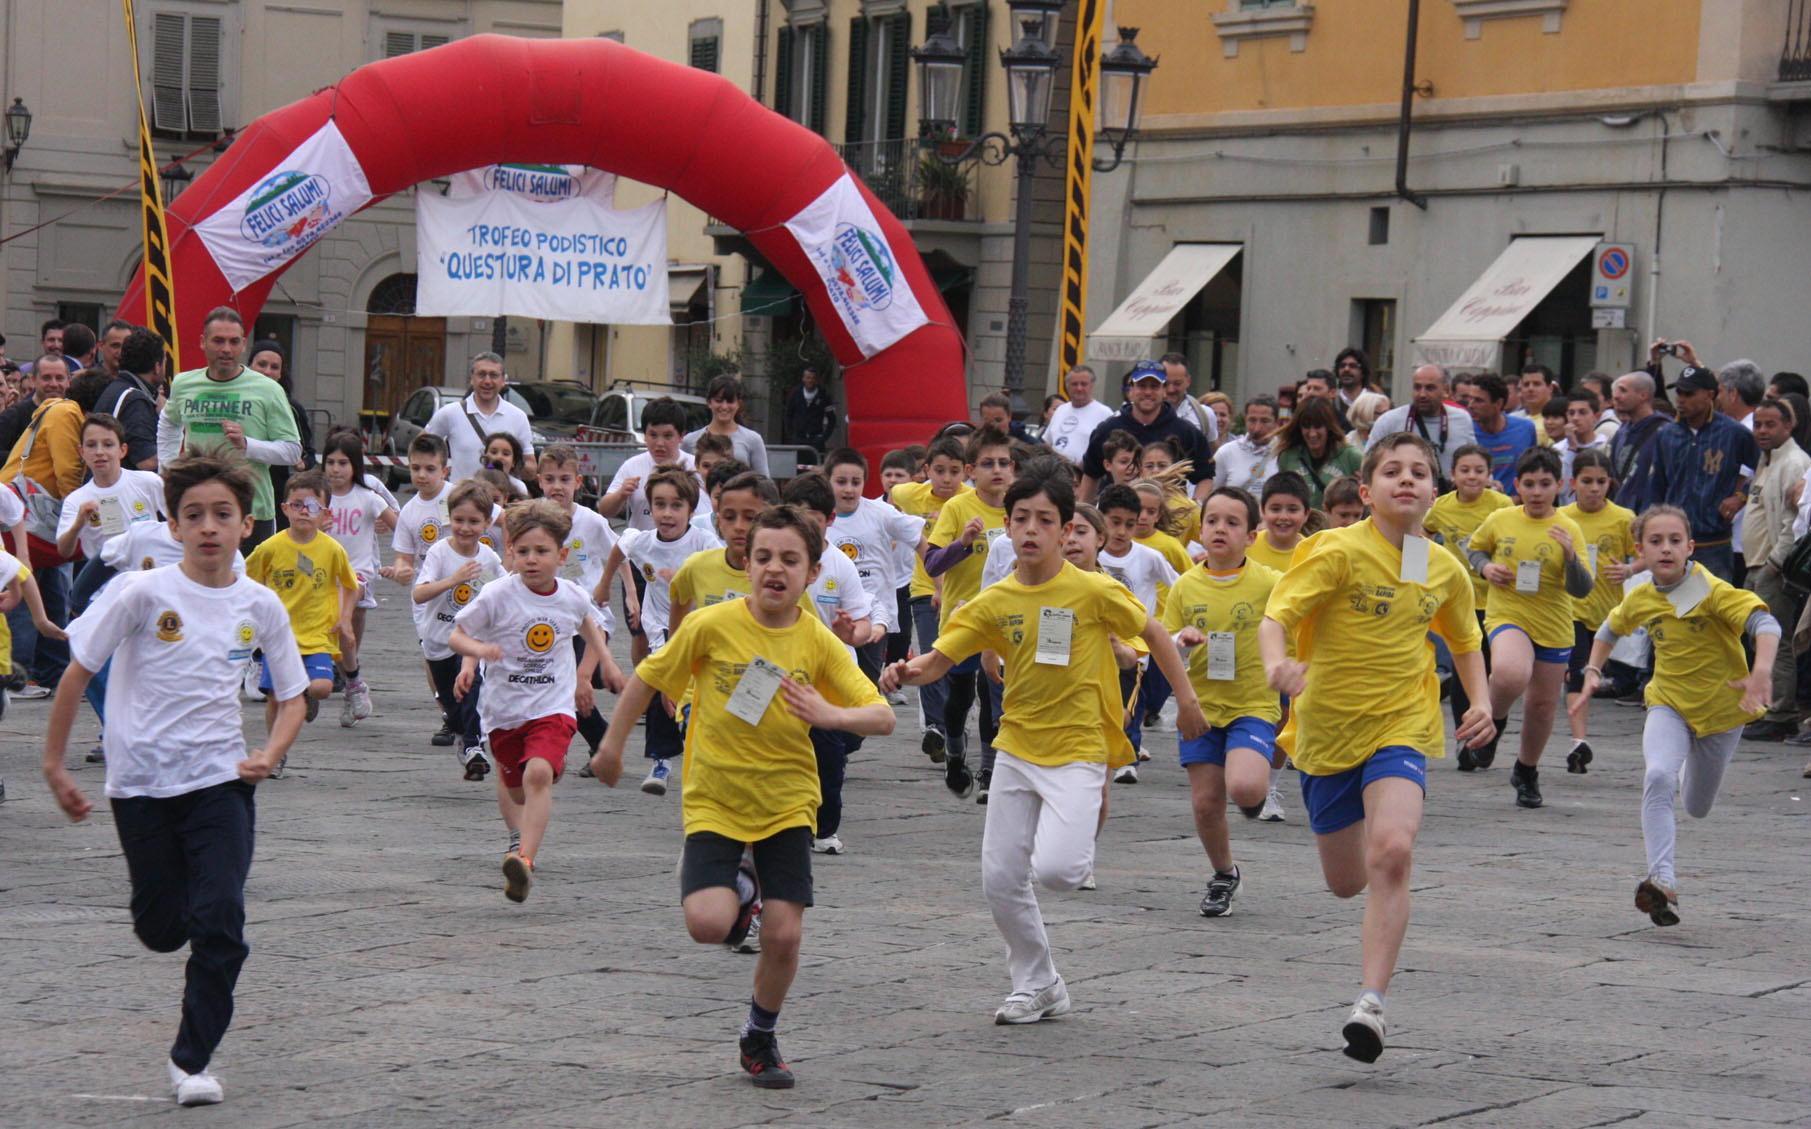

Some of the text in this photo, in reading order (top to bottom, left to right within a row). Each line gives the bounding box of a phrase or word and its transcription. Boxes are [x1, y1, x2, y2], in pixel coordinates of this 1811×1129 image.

[493, 167, 571, 196] FELICI SALUMI
[246, 199, 286, 240] FELICI
[281, 178, 325, 218] SALUMI
[468, 224, 628, 258] TROFEO PODISTICO
[440, 252, 652, 291] "QUESTURA DI PRATO"
[835, 227, 890, 305] FELICI SALUMI
[184, 399, 252, 417] PARTNER
[330, 507, 362, 536] HIC
[508, 674, 555, 685] DECATHLON
